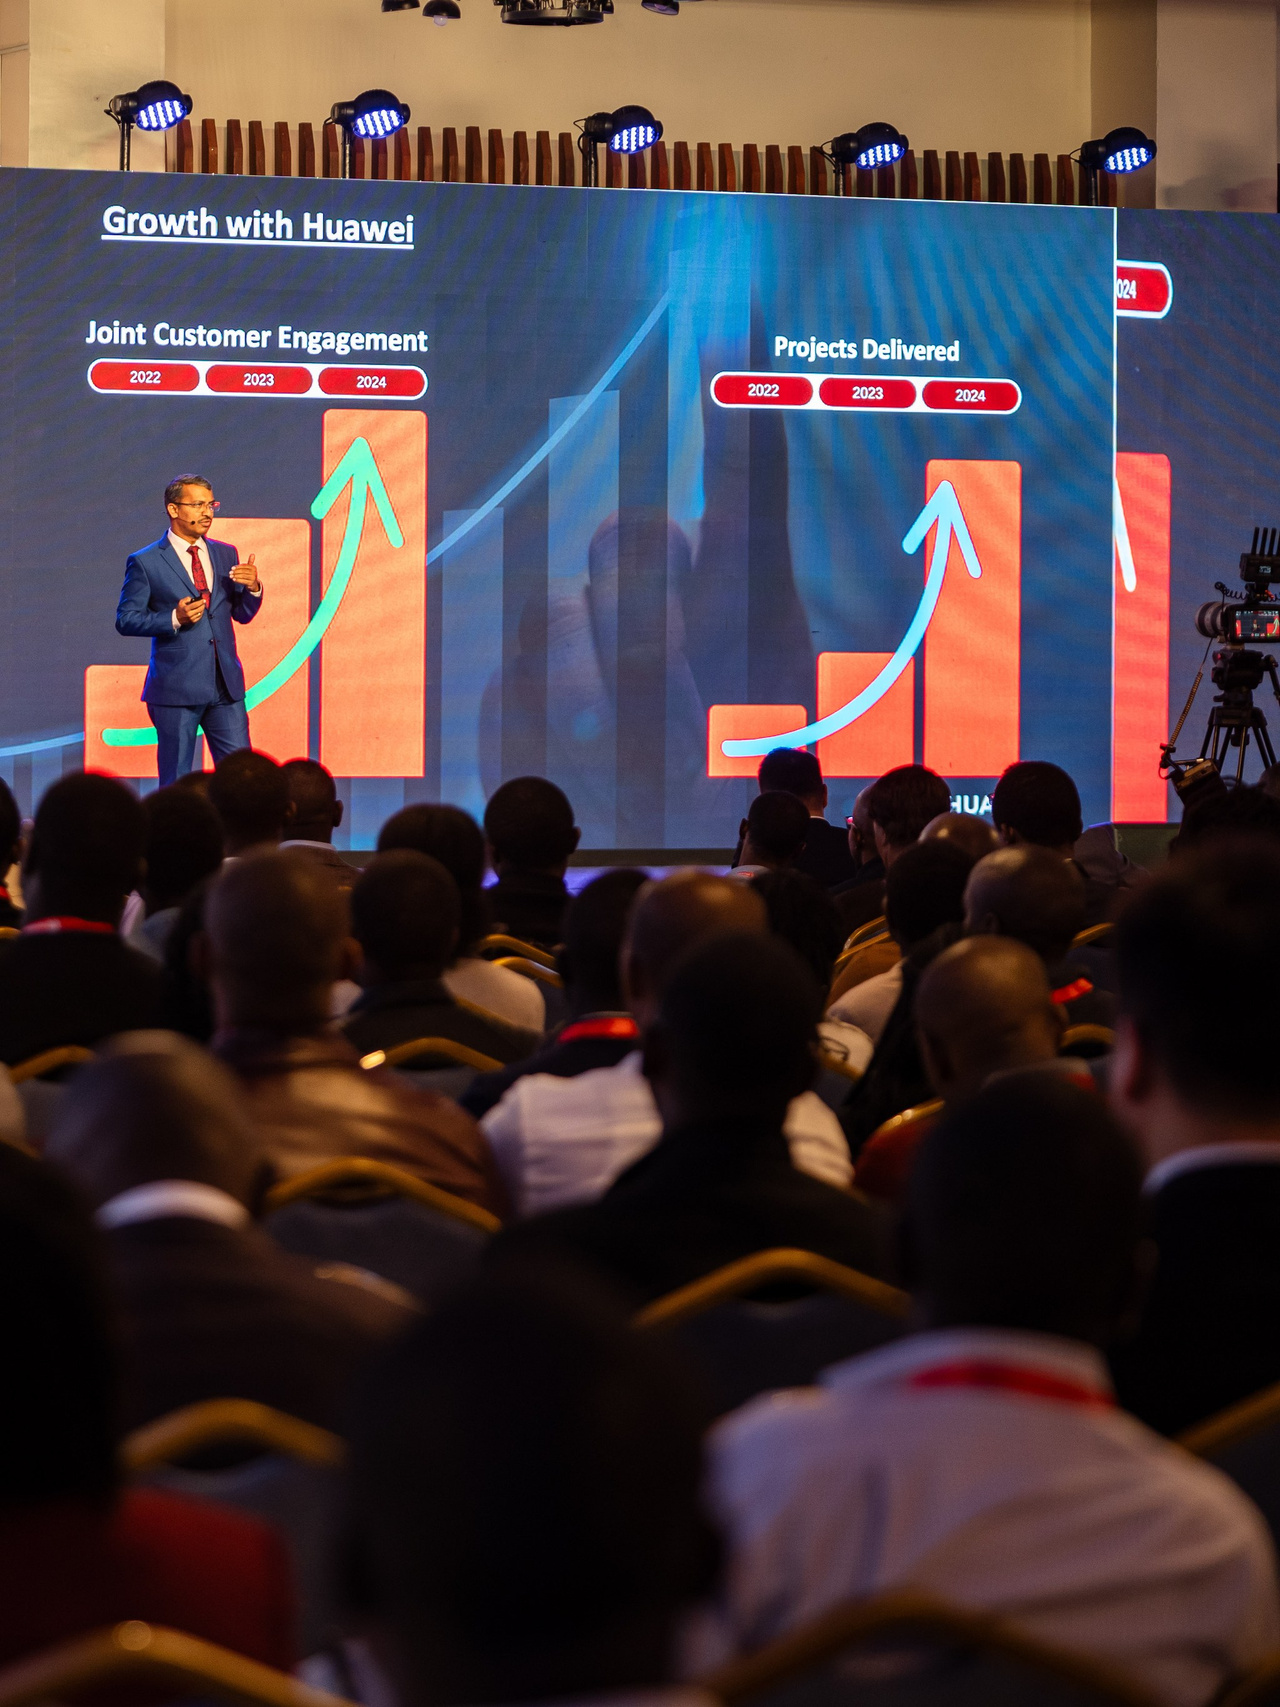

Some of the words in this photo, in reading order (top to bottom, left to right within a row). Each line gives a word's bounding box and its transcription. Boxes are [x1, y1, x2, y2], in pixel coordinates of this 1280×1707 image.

[102, 205, 218, 237] Growth
[226, 209, 293, 239] with
[303, 211, 415, 243] Huawei
[85, 320, 147, 345] Joint
[153, 322, 272, 348] Customer
[278, 325, 428, 354] Engagement
[775, 336, 857, 362] Projects
[863, 338, 960, 361] Delivered
[130, 370, 161, 384] 2022
[243, 373, 275, 387] 2023
[356, 375, 387, 389] 2024
[748, 383, 780, 397] 2022
[852, 386, 884, 400] 2023
[955, 388, 986, 402] 2024
